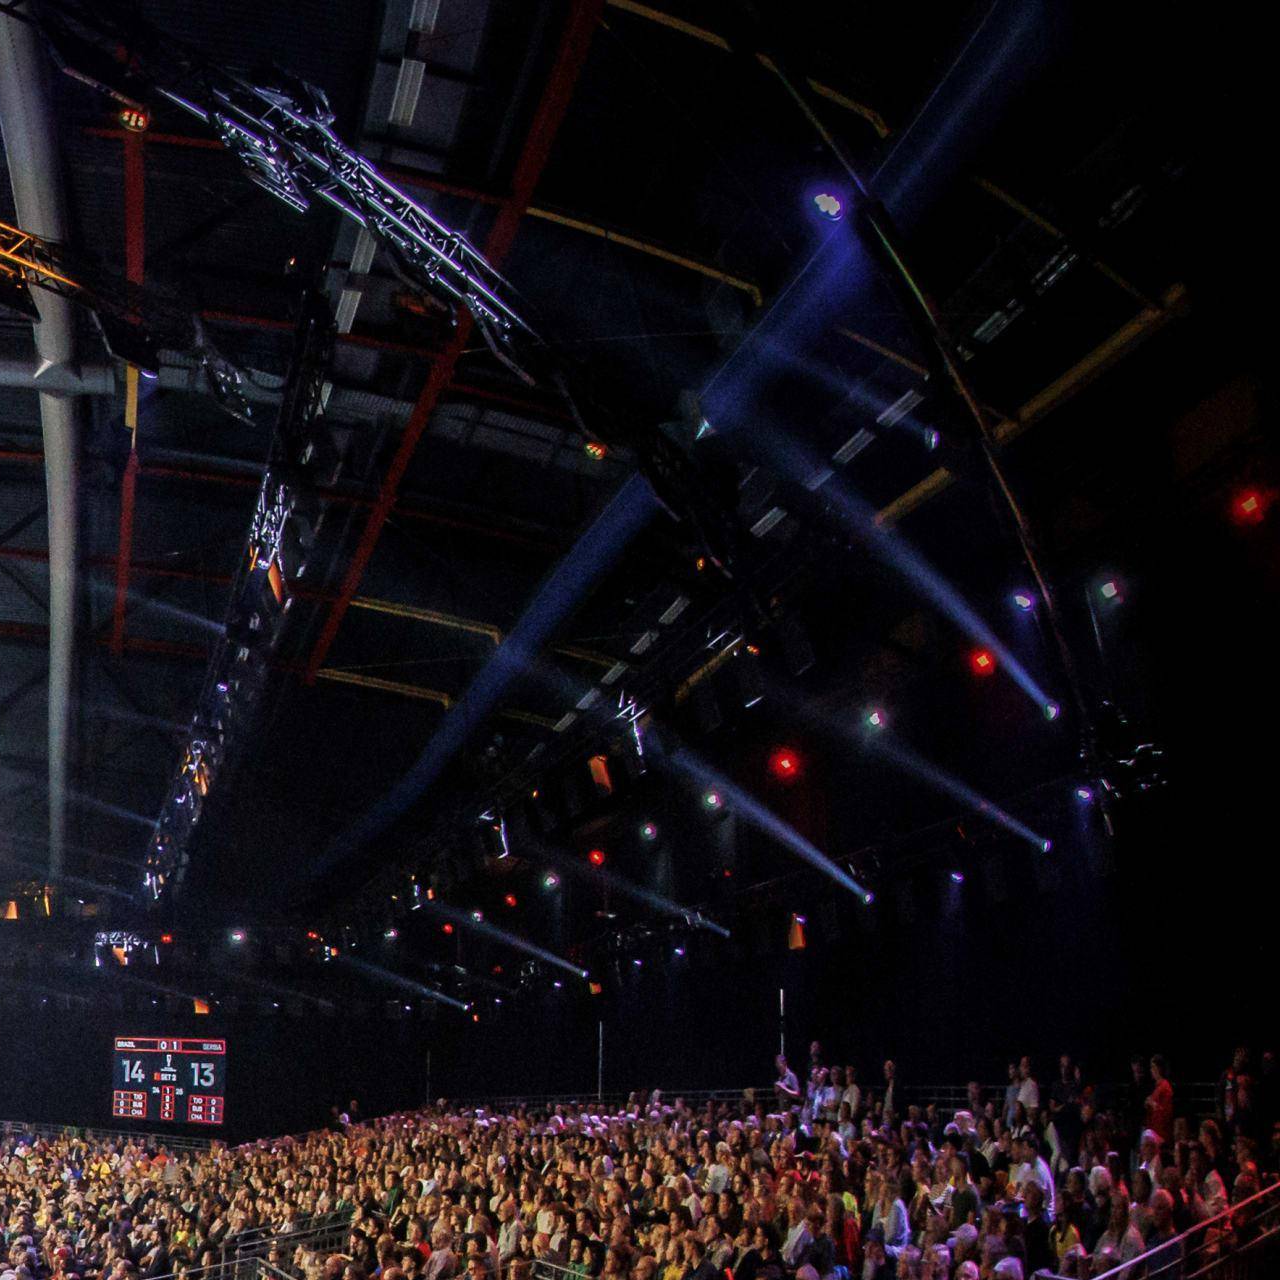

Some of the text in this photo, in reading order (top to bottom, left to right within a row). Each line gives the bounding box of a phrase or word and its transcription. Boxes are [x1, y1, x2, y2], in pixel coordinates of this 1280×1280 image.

[160, 1041, 177, 1050] 0 1
[122, 1059, 145, 1082] 14
[190, 1062, 215, 1087] 13
